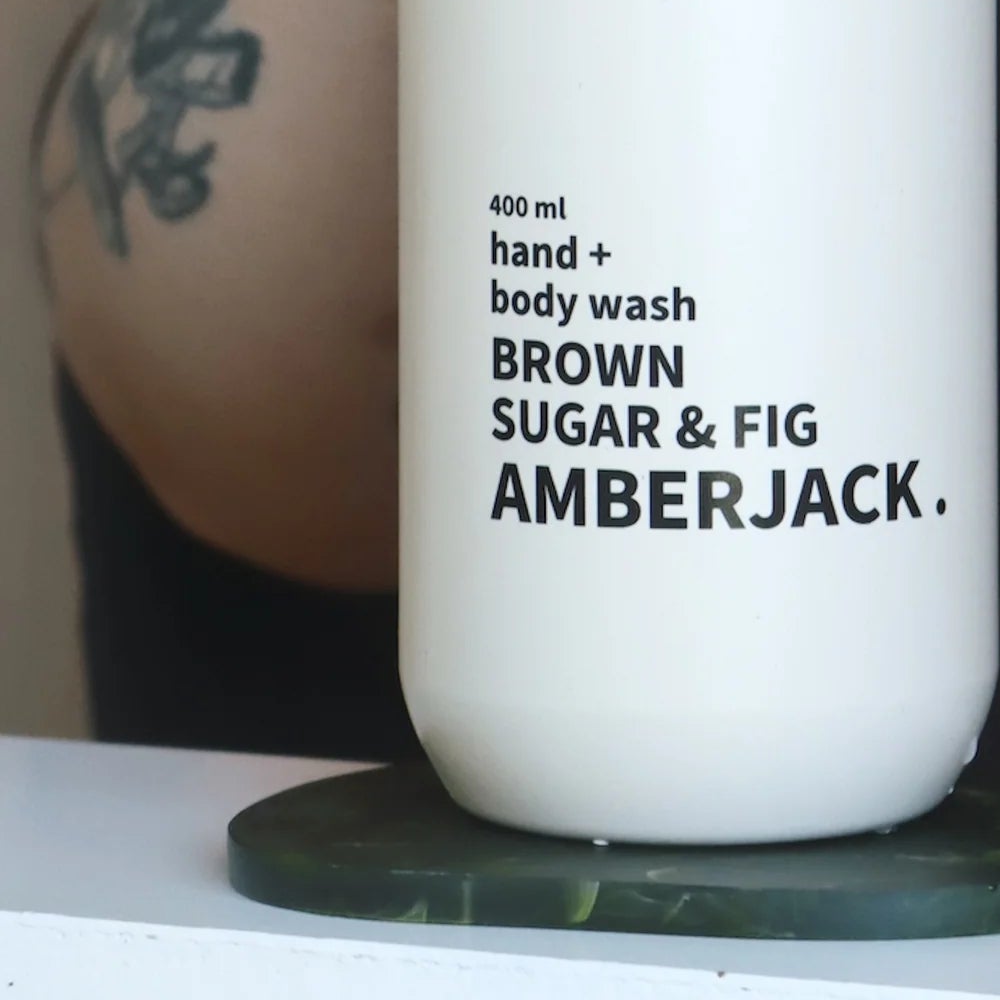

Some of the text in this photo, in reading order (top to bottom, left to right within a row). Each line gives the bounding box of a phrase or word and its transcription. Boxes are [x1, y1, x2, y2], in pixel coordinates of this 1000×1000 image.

[488, 194, 567, 221] 400 ml
[490, 229, 612, 271] hand +
[490, 277, 696, 328] body wash
[492, 336, 684, 389] BROWN
[491, 396, 818, 450] SUGAR & FIG
